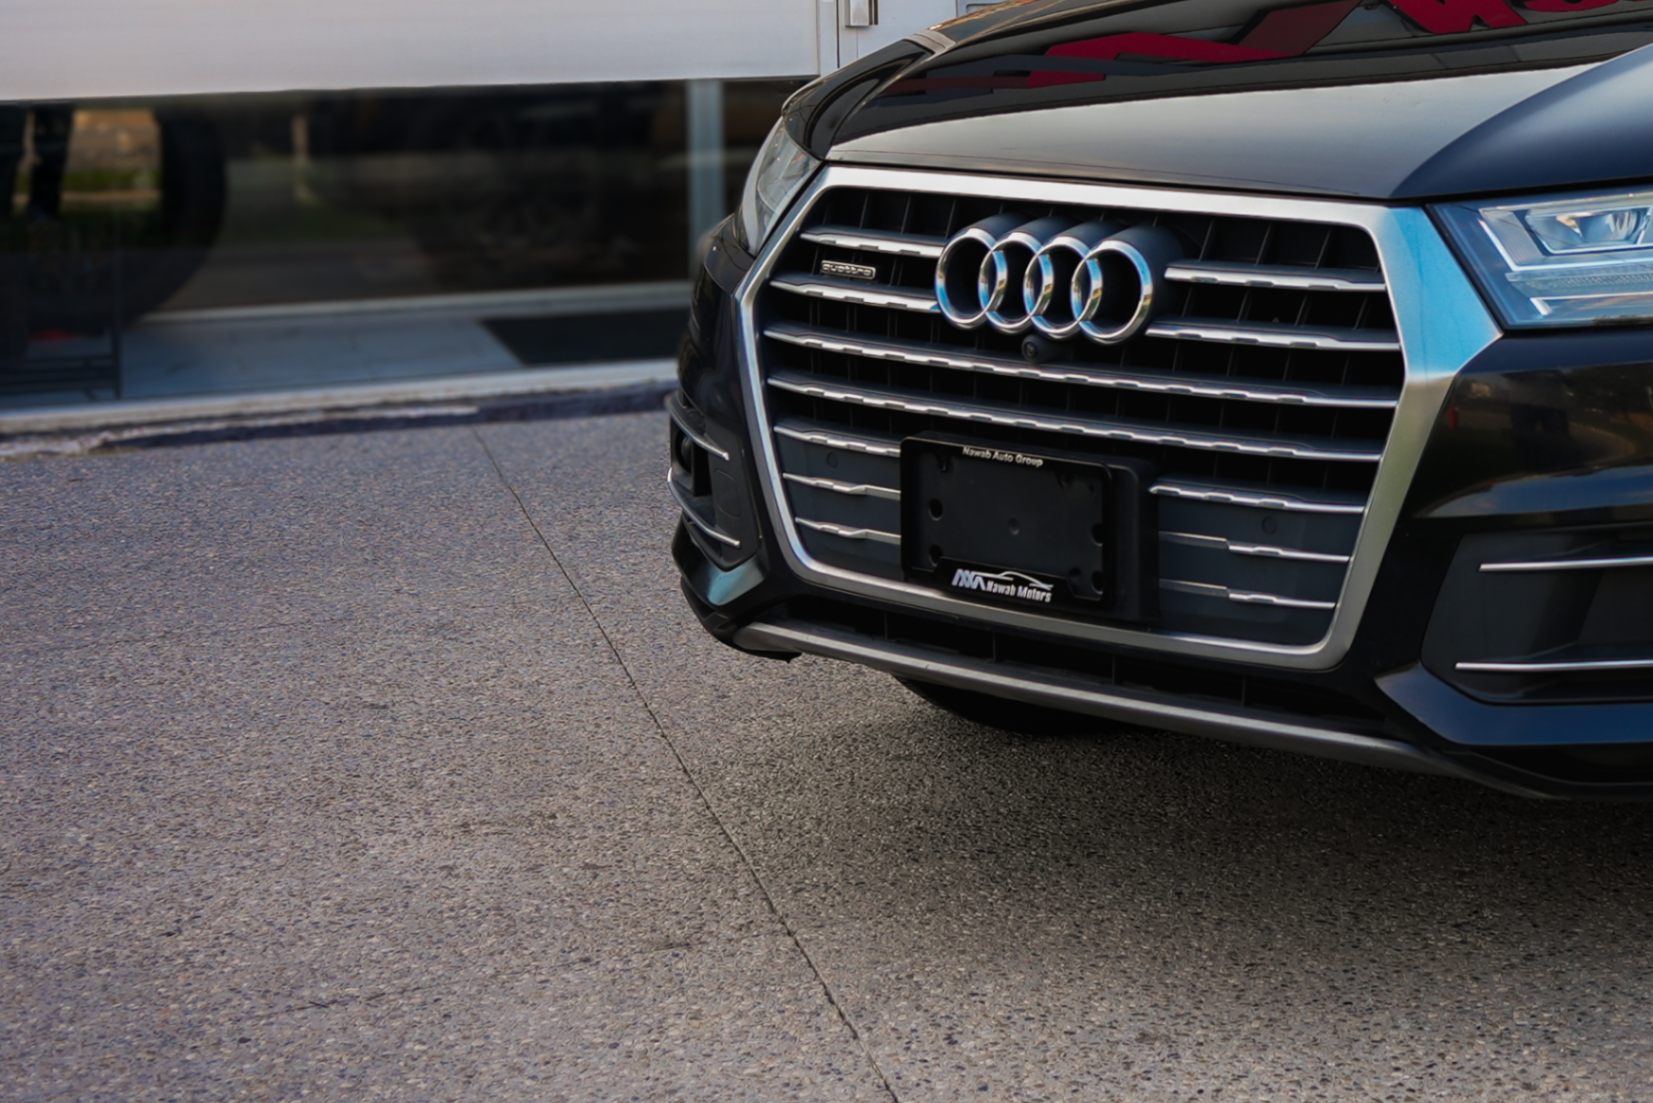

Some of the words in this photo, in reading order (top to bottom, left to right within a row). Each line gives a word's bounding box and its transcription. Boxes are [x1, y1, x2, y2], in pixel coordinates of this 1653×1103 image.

[962, 446, 992, 459] Nawab
[992, 450, 1014, 463] Auto
[1015, 453, 1044, 468] Group
[986, 580, 1016, 596] Nawab
[1016, 585, 1053, 603] Motors
